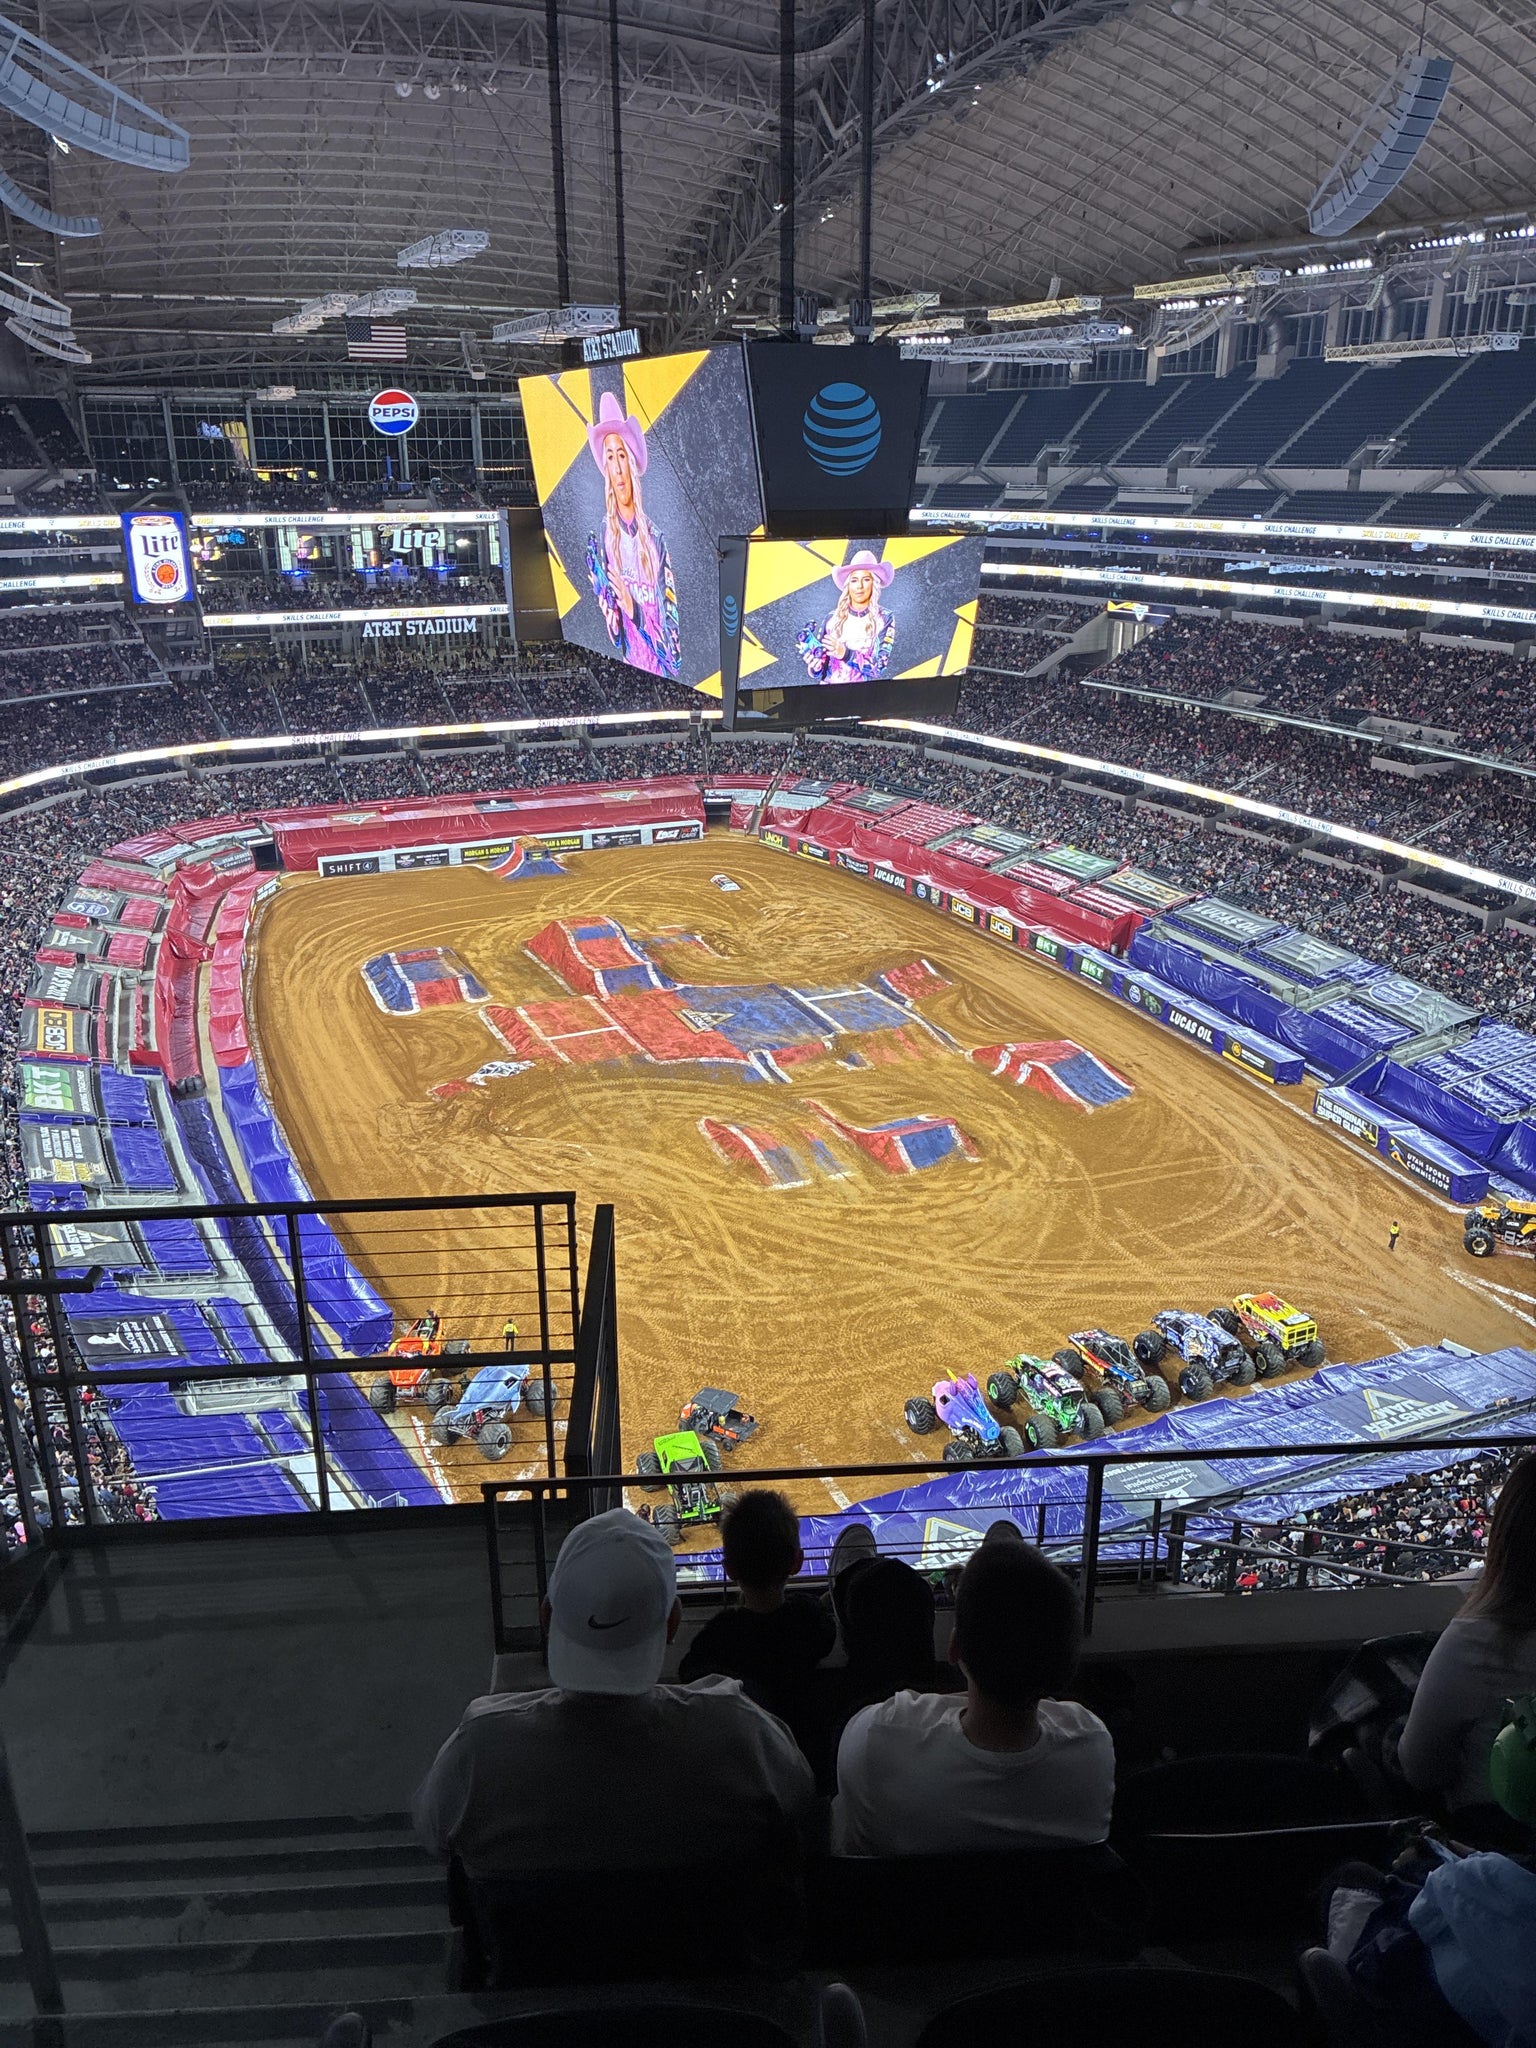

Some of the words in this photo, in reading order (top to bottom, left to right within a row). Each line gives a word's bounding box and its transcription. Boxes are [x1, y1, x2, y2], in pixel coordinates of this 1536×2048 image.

[582, 336, 602, 362] AT&T
[601, 328, 640, 358] STADIUM
[372, 408, 414, 418] PEPSI
[1283, 526, 1317, 535] CHALLENGE
[140, 534, 178, 558] Lite
[390, 529, 440, 553] Lite
[1470, 534, 1493, 544] SKILLS
[1495, 536, 1535, 547] CHALLENGE
[1274, 587, 1292, 596] SKILLS
[1294, 590, 1327, 599] CHALLENGE
[1482, 607, 1505, 617] SKILLS
[363, 621, 402, 637] AT&T
[406, 618, 477, 635] STADIUM
[61, 764, 82, 774] SKILLS
[83, 758, 117, 771] CHALLENGE
[1278, 810, 1298, 821] SKILLS
[1299, 815, 1333, 833] CHALLENGE
[765, 831, 783, 844] UNOH
[329, 863, 361, 873] SHIFT
[874, 868, 893, 884] LUCAS
[894, 876, 905, 889] OIL
[1498, 878, 1523, 894] SKILLS
[953, 902, 972, 918] JCB
[1192, 905, 1239, 925] LUCAS
[1236, 920, 1265, 934] OIL
[992, 920, 1011, 936] JCB
[1036, 937, 1057, 954] BKT
[54, 966, 77, 979] OIL
[1081, 959, 1104, 978] BKT
[45, 977, 72, 1001] LUCAS
[1169, 1010, 1197, 1034] LUCAS
[1198, 1025, 1213, 1044] OIL
[45, 1026, 65, 1050] JCB
[32, 1066, 64, 1109] BKT
[1317, 1106, 1342, 1126] SUPER
[1342, 1121, 1362, 1137] GLUE
[1320, 1097, 1333, 1110] THE
[1333, 1104, 1367, 1129] ORIGINAL
[1406, 1161, 1450, 1191] COMMISSION
[1407, 1153, 1424, 1167] UTAH
[1425, 1164, 1450, 1183] SPORTS
[1361, 1400, 1459, 1434] MONSTER
[1374, 1400, 1416, 1419] JAM
